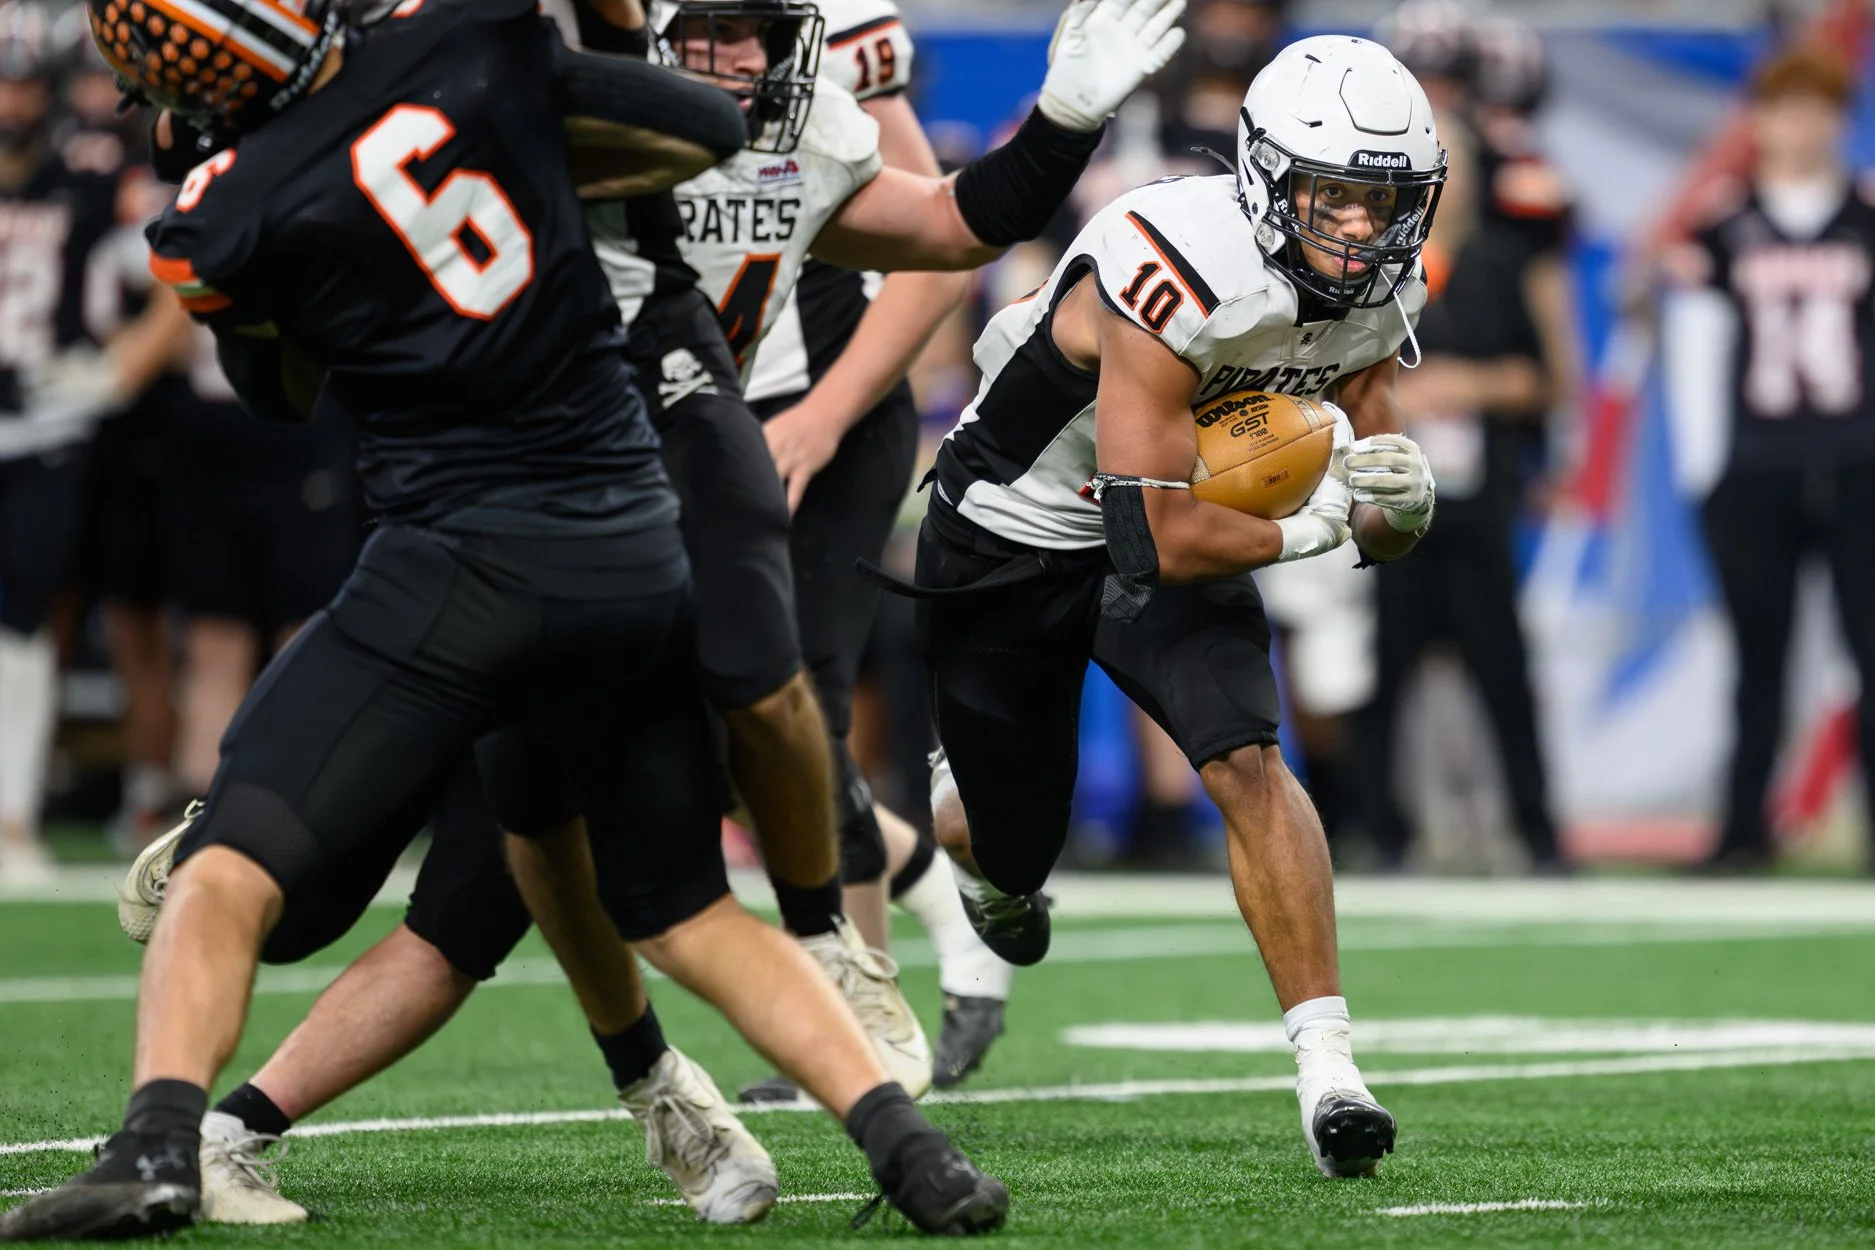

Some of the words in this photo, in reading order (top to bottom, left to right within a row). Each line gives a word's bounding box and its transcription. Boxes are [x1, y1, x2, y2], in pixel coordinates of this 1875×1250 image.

[853, 38, 896, 91] 19
[176, 147, 237, 213] 6
[1358, 152, 1408, 168] Riddell
[350, 102, 535, 323] 6
[677, 198, 800, 243] RATES
[1396, 204, 1425, 245] iddell
[1119, 260, 1184, 334] 10
[1230, 411, 1269, 438] GST
